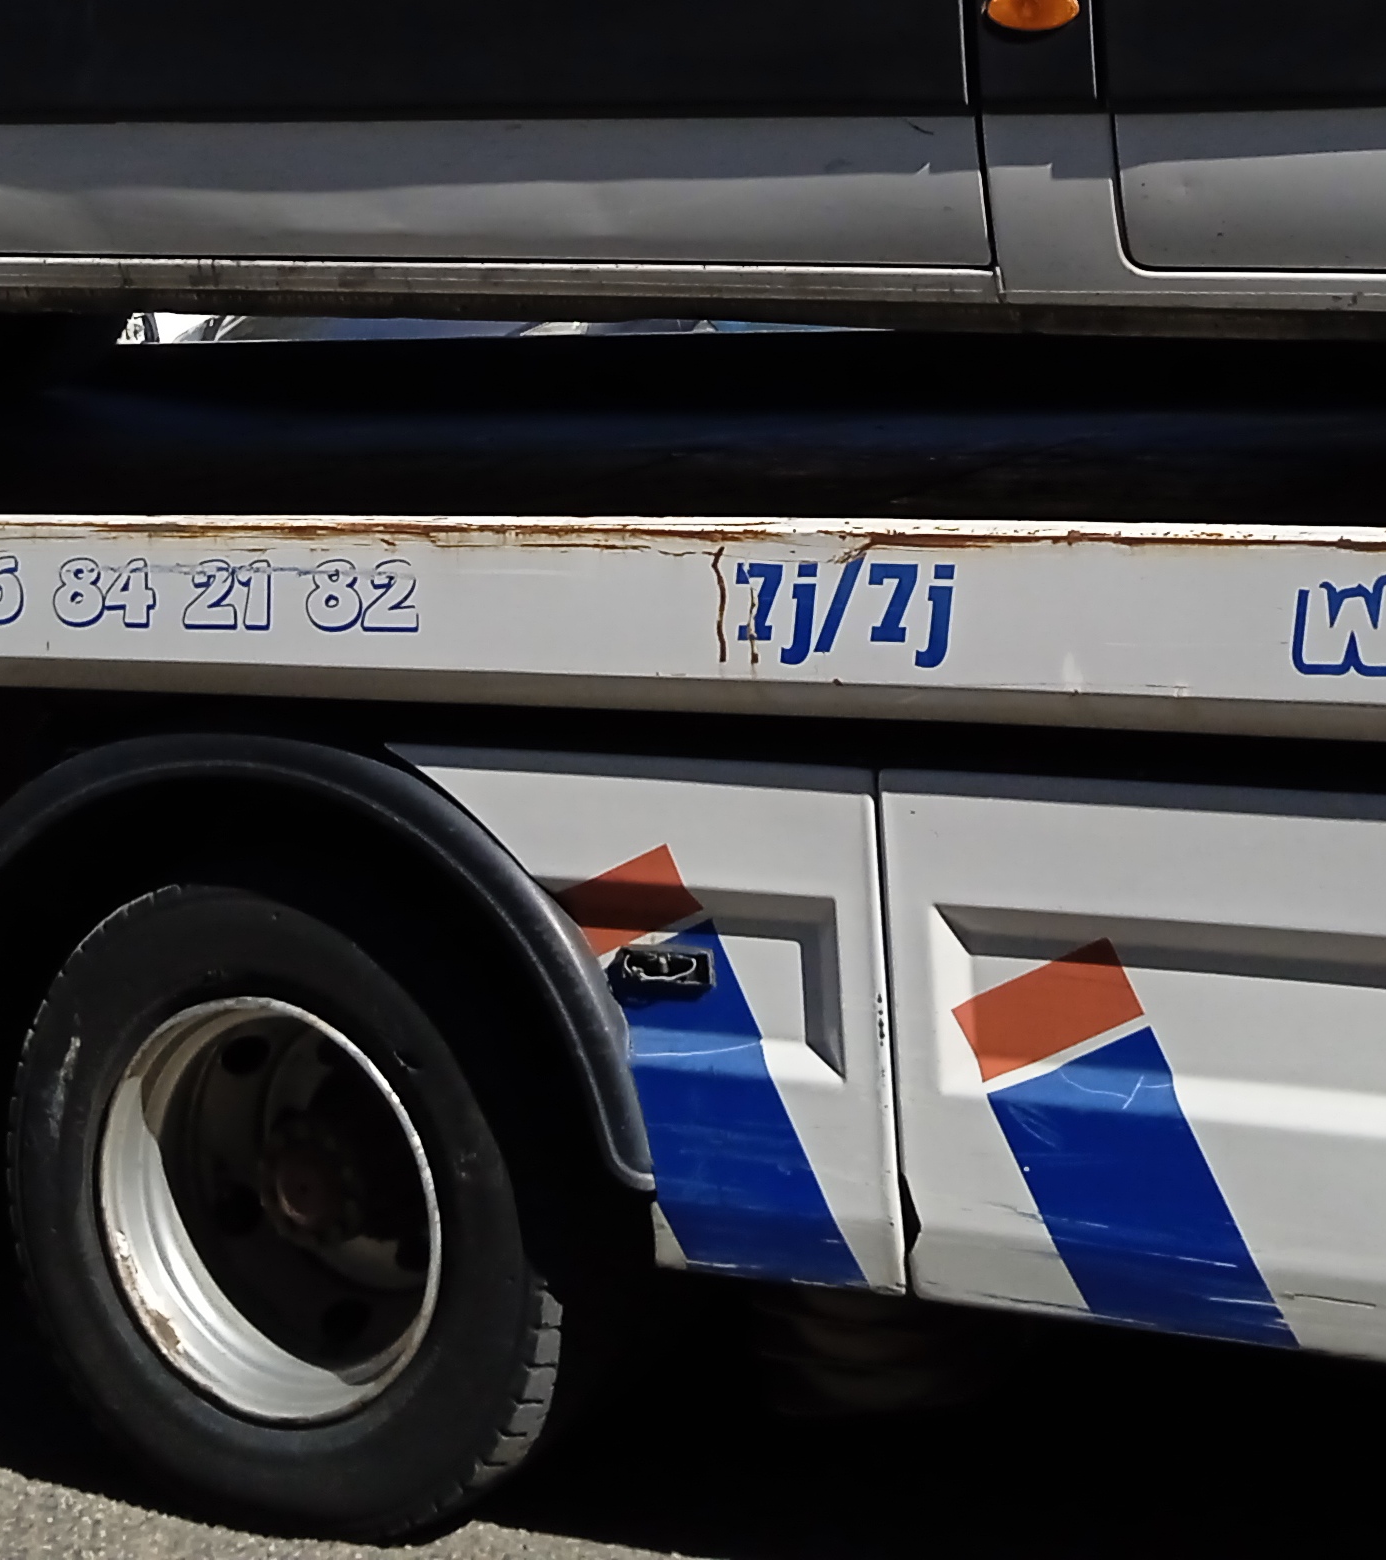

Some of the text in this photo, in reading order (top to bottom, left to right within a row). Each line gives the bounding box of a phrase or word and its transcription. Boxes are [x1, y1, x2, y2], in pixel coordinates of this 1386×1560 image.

[53, 556, 157, 629] 84
[182, 558, 272, 631] 21
[305, 558, 420, 633] 82
[735, 552, 956, 668] 7j/7j
